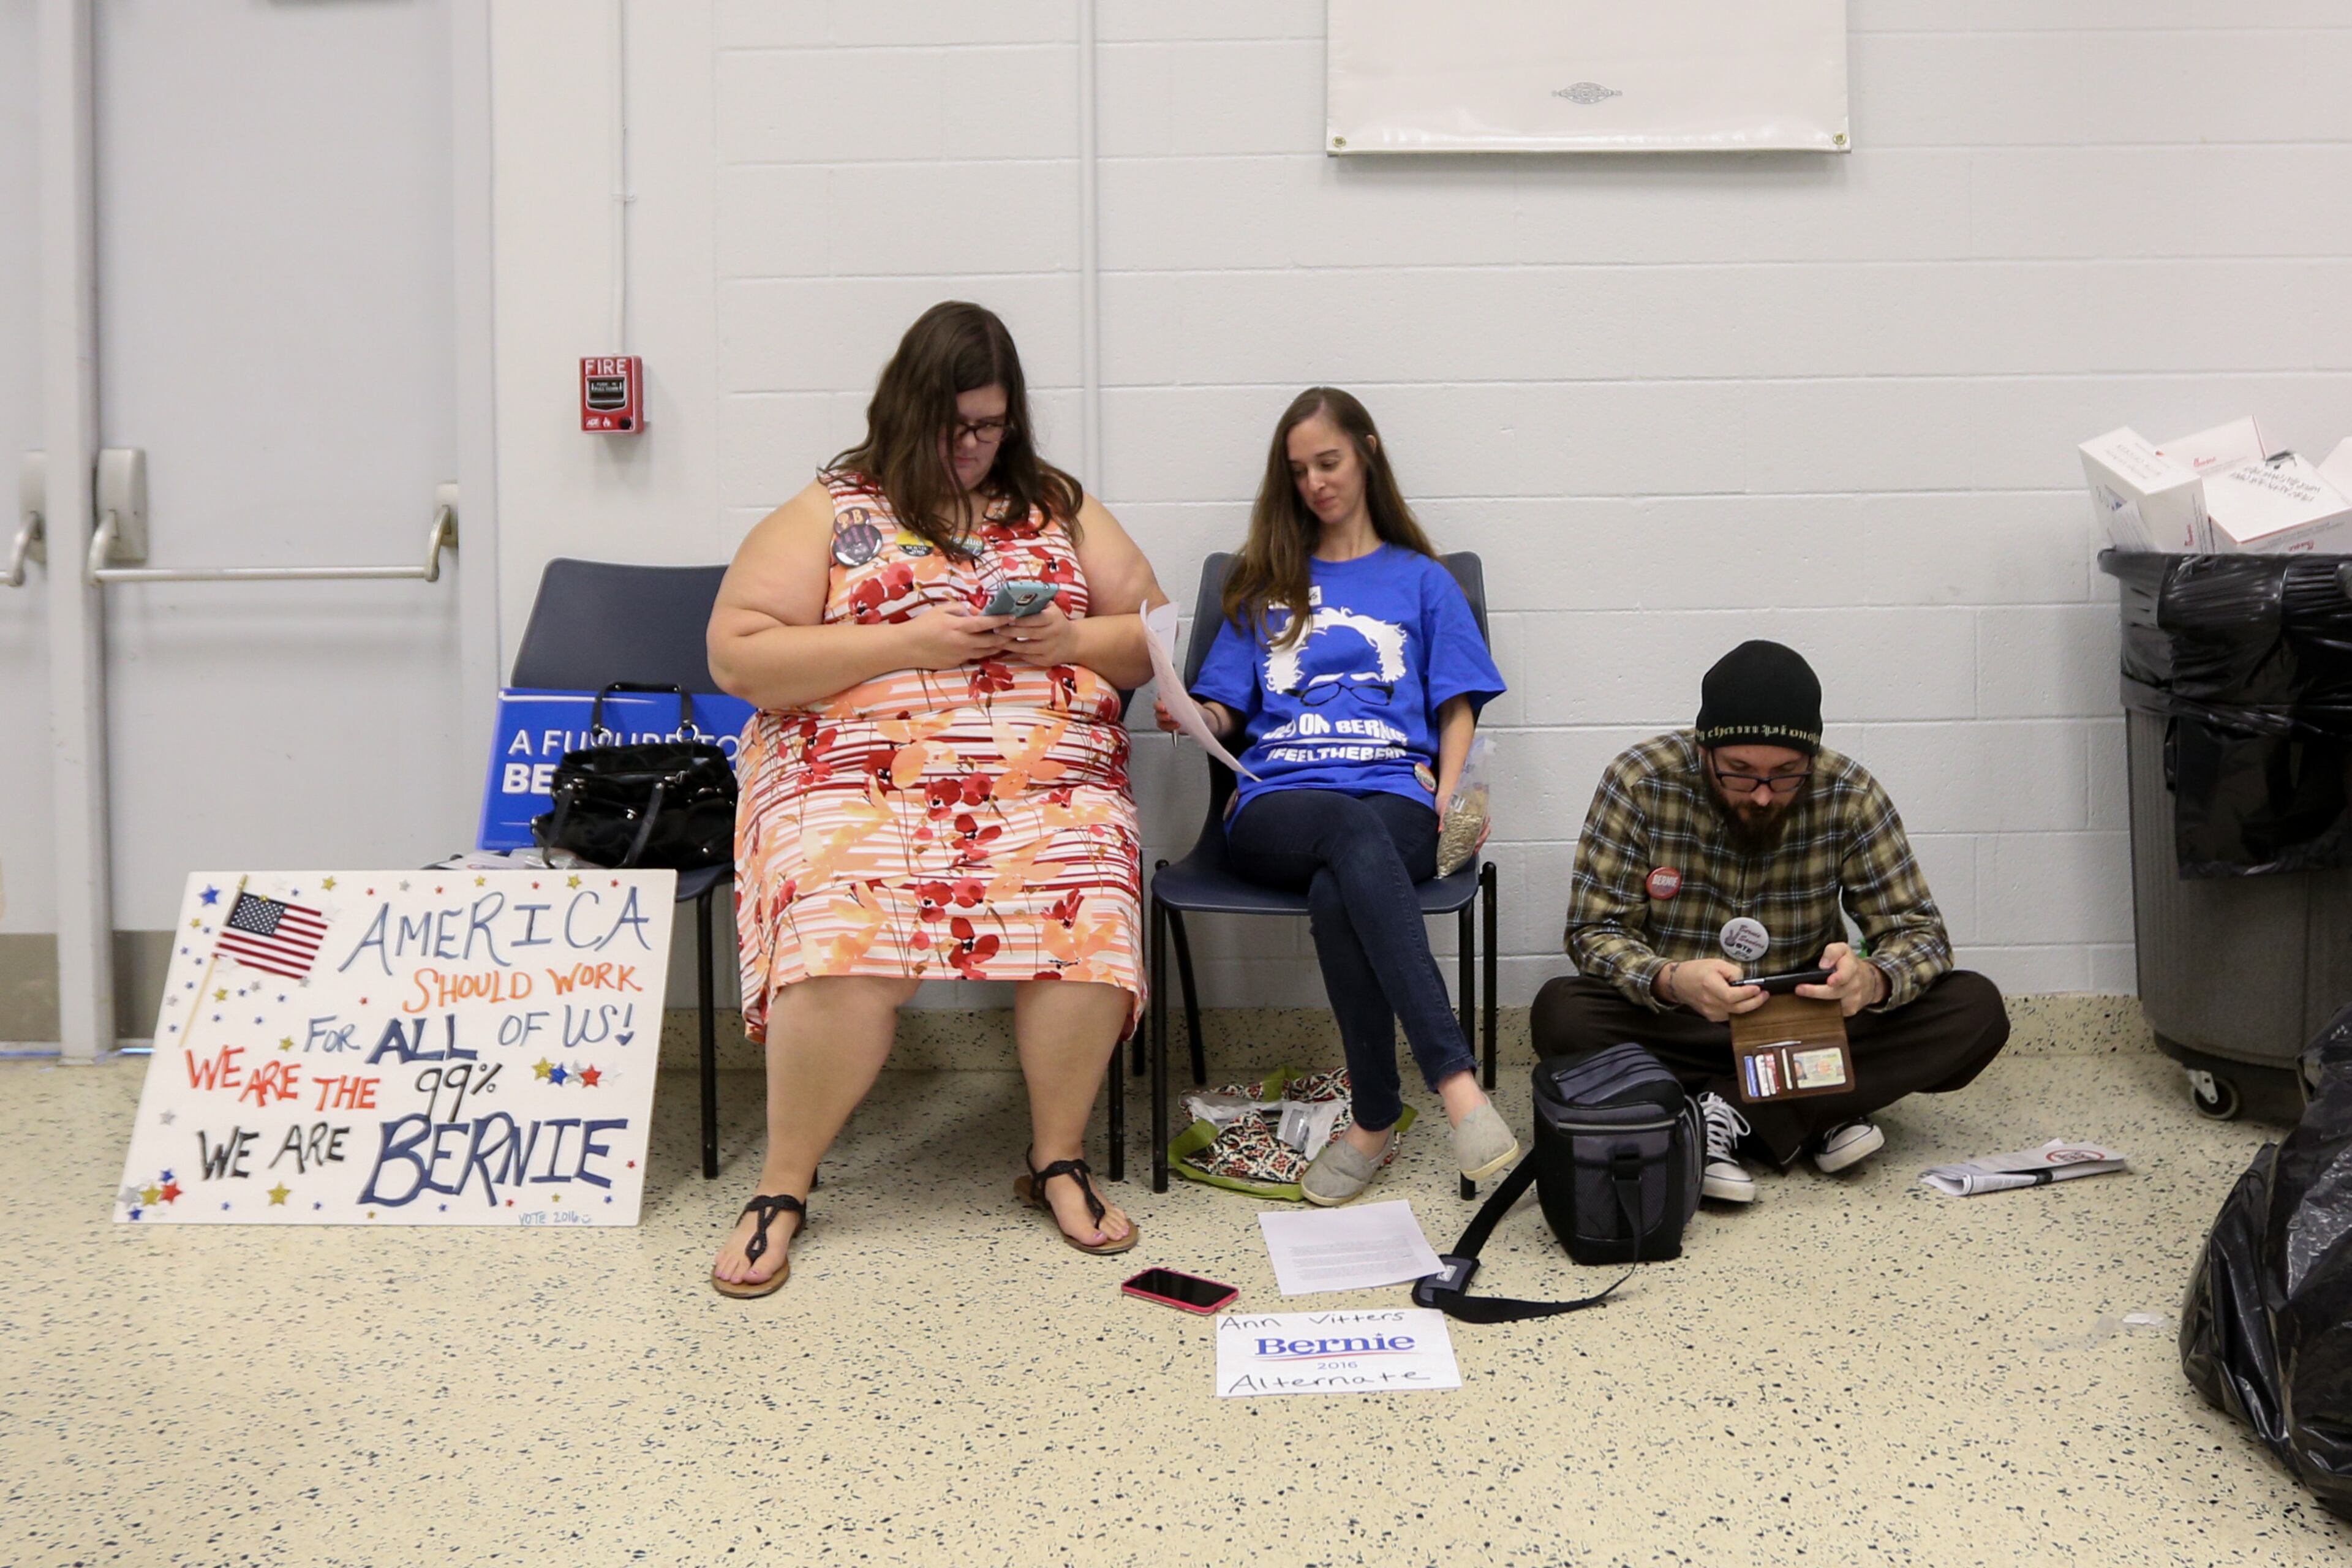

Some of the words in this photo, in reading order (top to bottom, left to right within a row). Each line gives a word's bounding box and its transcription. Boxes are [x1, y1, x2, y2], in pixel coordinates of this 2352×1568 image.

[584, 358, 627, 375] FIRE
[508, 729, 533, 756] A
[337, 886, 651, 976] AMERICA
[402, 968, 533, 1014] SHOULD
[546, 962, 643, 997] WORK
[303, 1015, 361, 1053] FOR
[364, 1014, 478, 1065] ALL
[497, 1011, 550, 1047] OF
[184, 1044, 244, 1091] WE
[238, 1059, 302, 1107] ARE
[312, 1076, 380, 1112] THE
[415, 1062, 503, 1123] 99%
[197, 1125, 260, 1182] WE
[268, 1121, 351, 1174] ARE
[356, 1111, 630, 1208] BERNIE
[518, 1210, 546, 1225] VOTE
[552, 1210, 579, 1224] 2016
[1219, 1316, 1283, 1331] Ann
[1308, 1311, 1406, 1325] Vitters
[1254, 1332, 1415, 1355] Bernie
[1316, 1361, 1359, 1371] 2016
[1228, 1370, 1431, 1394] Alternate
